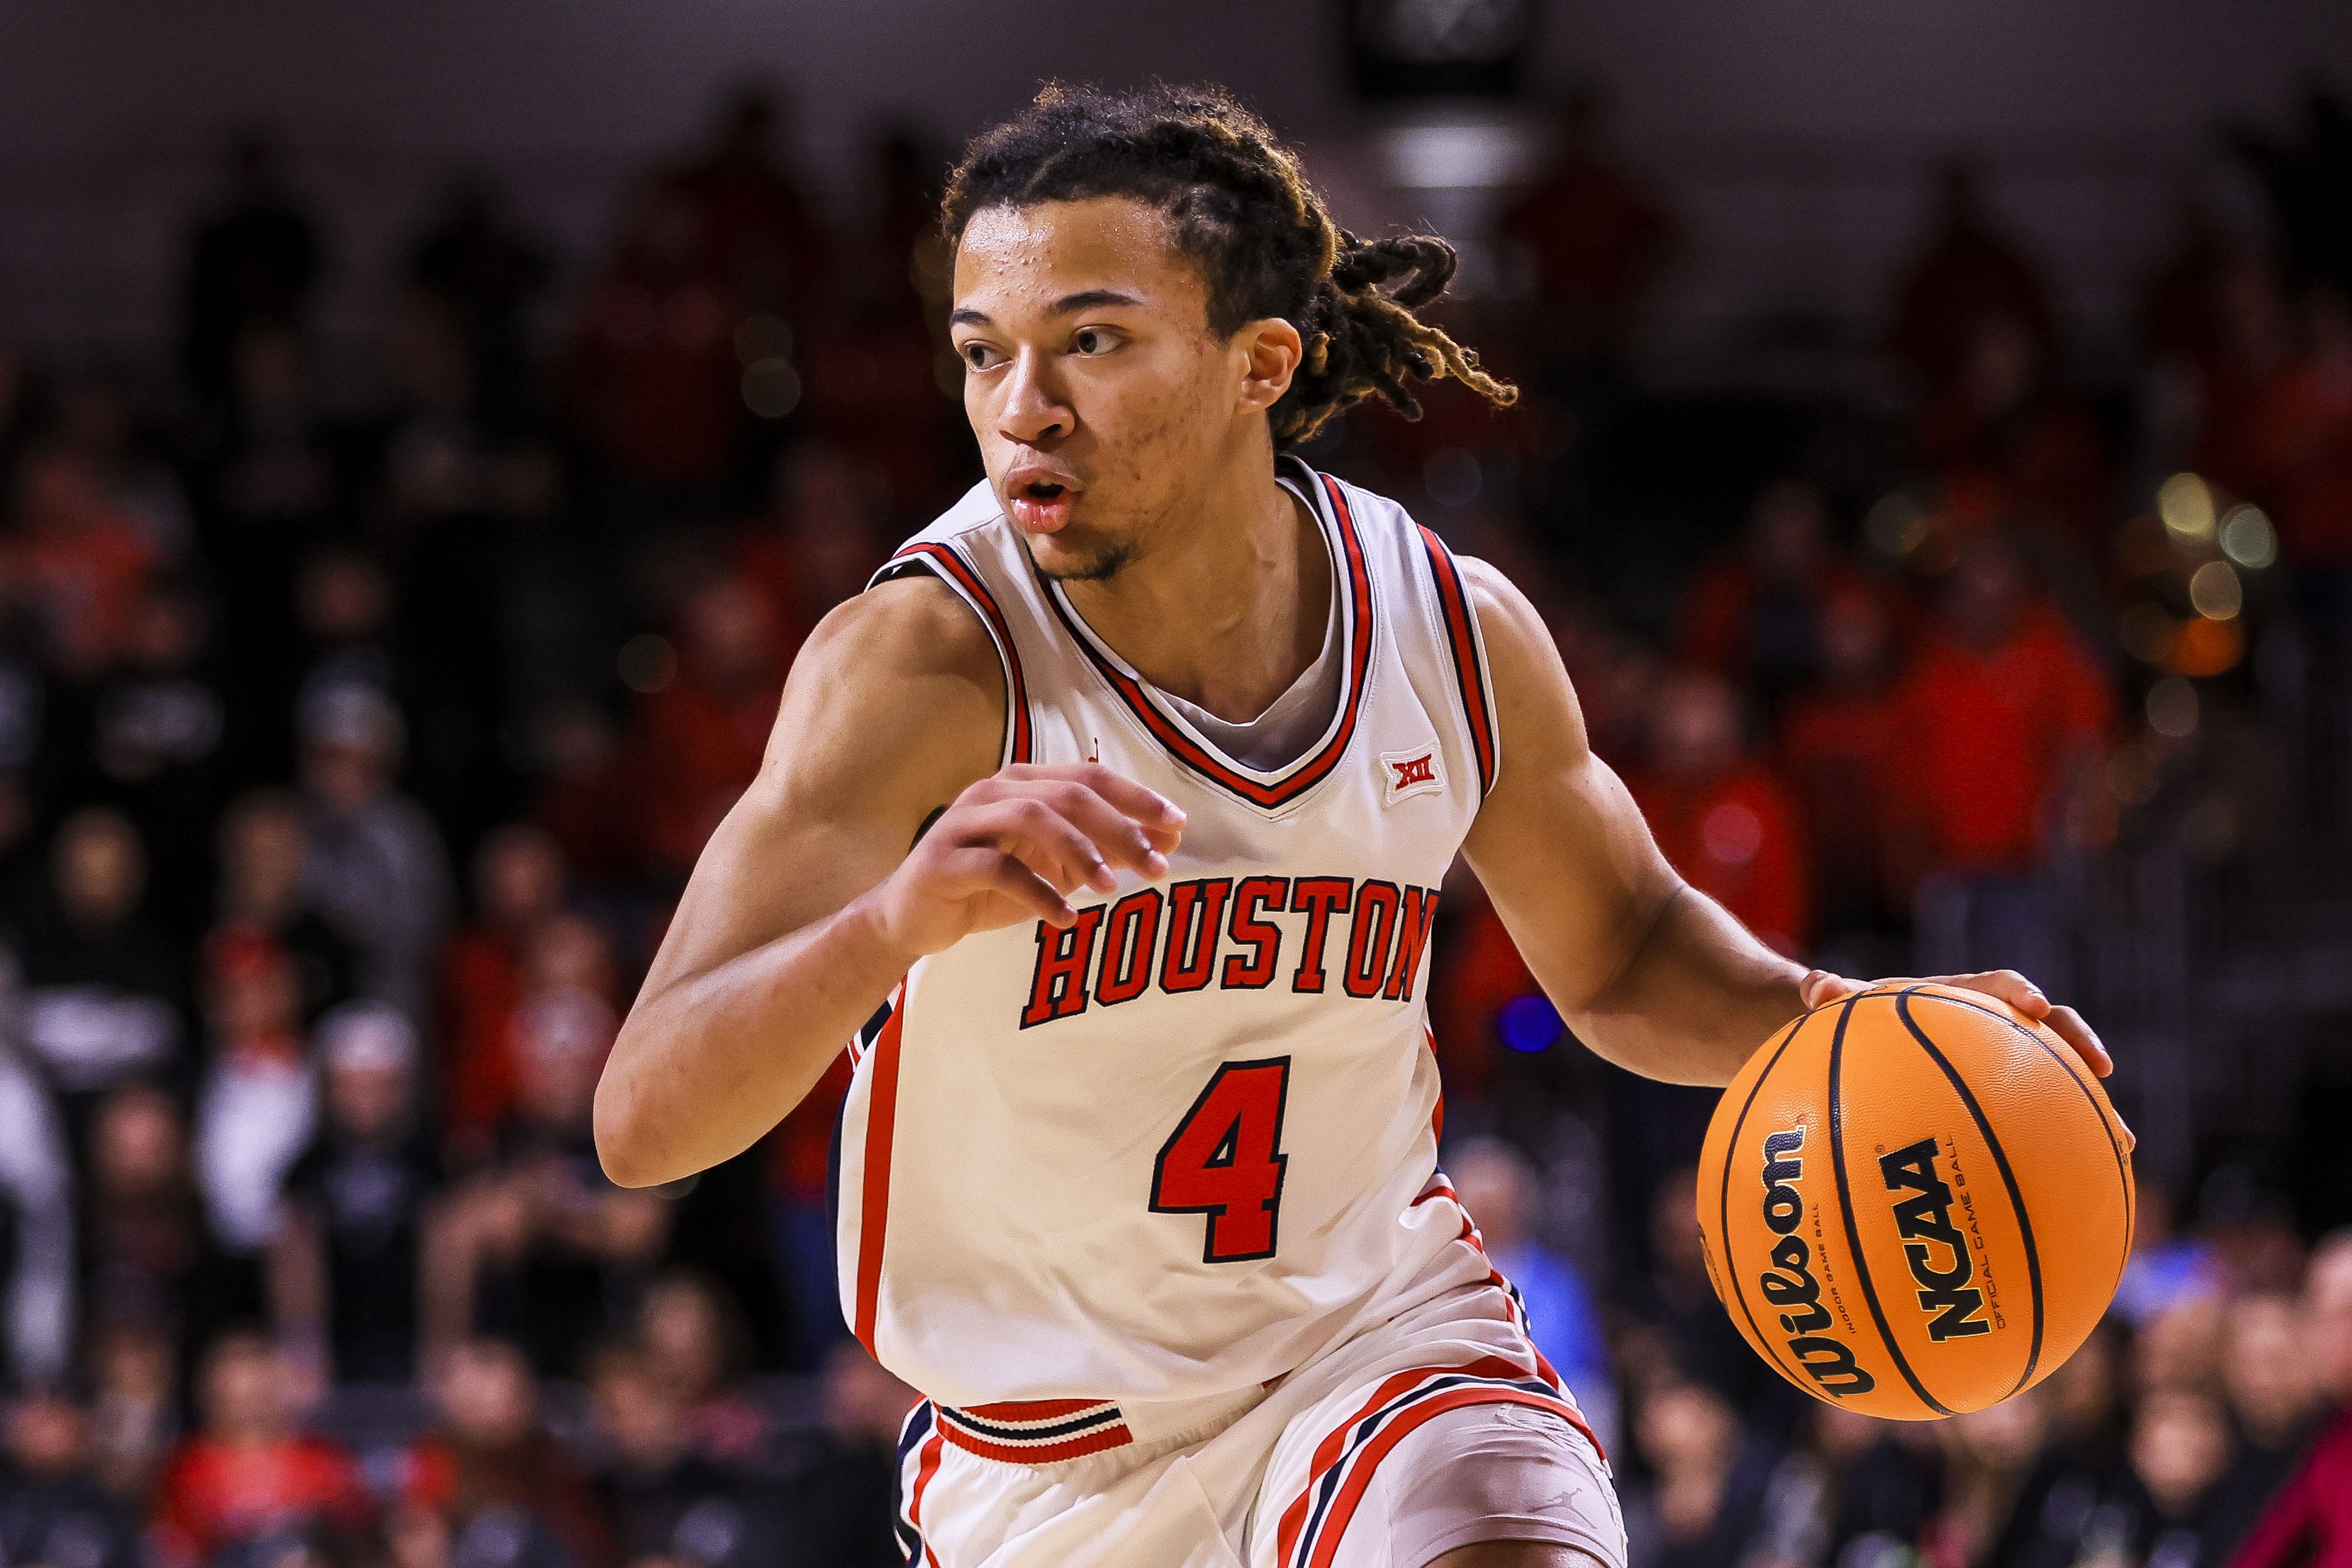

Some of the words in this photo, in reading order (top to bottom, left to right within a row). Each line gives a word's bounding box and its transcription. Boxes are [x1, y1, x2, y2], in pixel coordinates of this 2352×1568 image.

[1391, 752, 1436, 790] XII
[1019, 875, 1441, 1030] HOUSTON
[1148, 1055, 1291, 1264] 4
[1945, 1134, 1966, 1188] BALL
[1812, 1203, 1822, 1237] BALL
[1878, 1136, 1991, 1343] NCAA
[1960, 1191, 1984, 1250] GAME
[1760, 1124, 1876, 1399] Wilson
[1818, 1244, 1834, 1283] GAME
[1830, 1287, 1857, 1334] INDOOR
[1979, 1254, 2006, 1329] OFFICIAL
